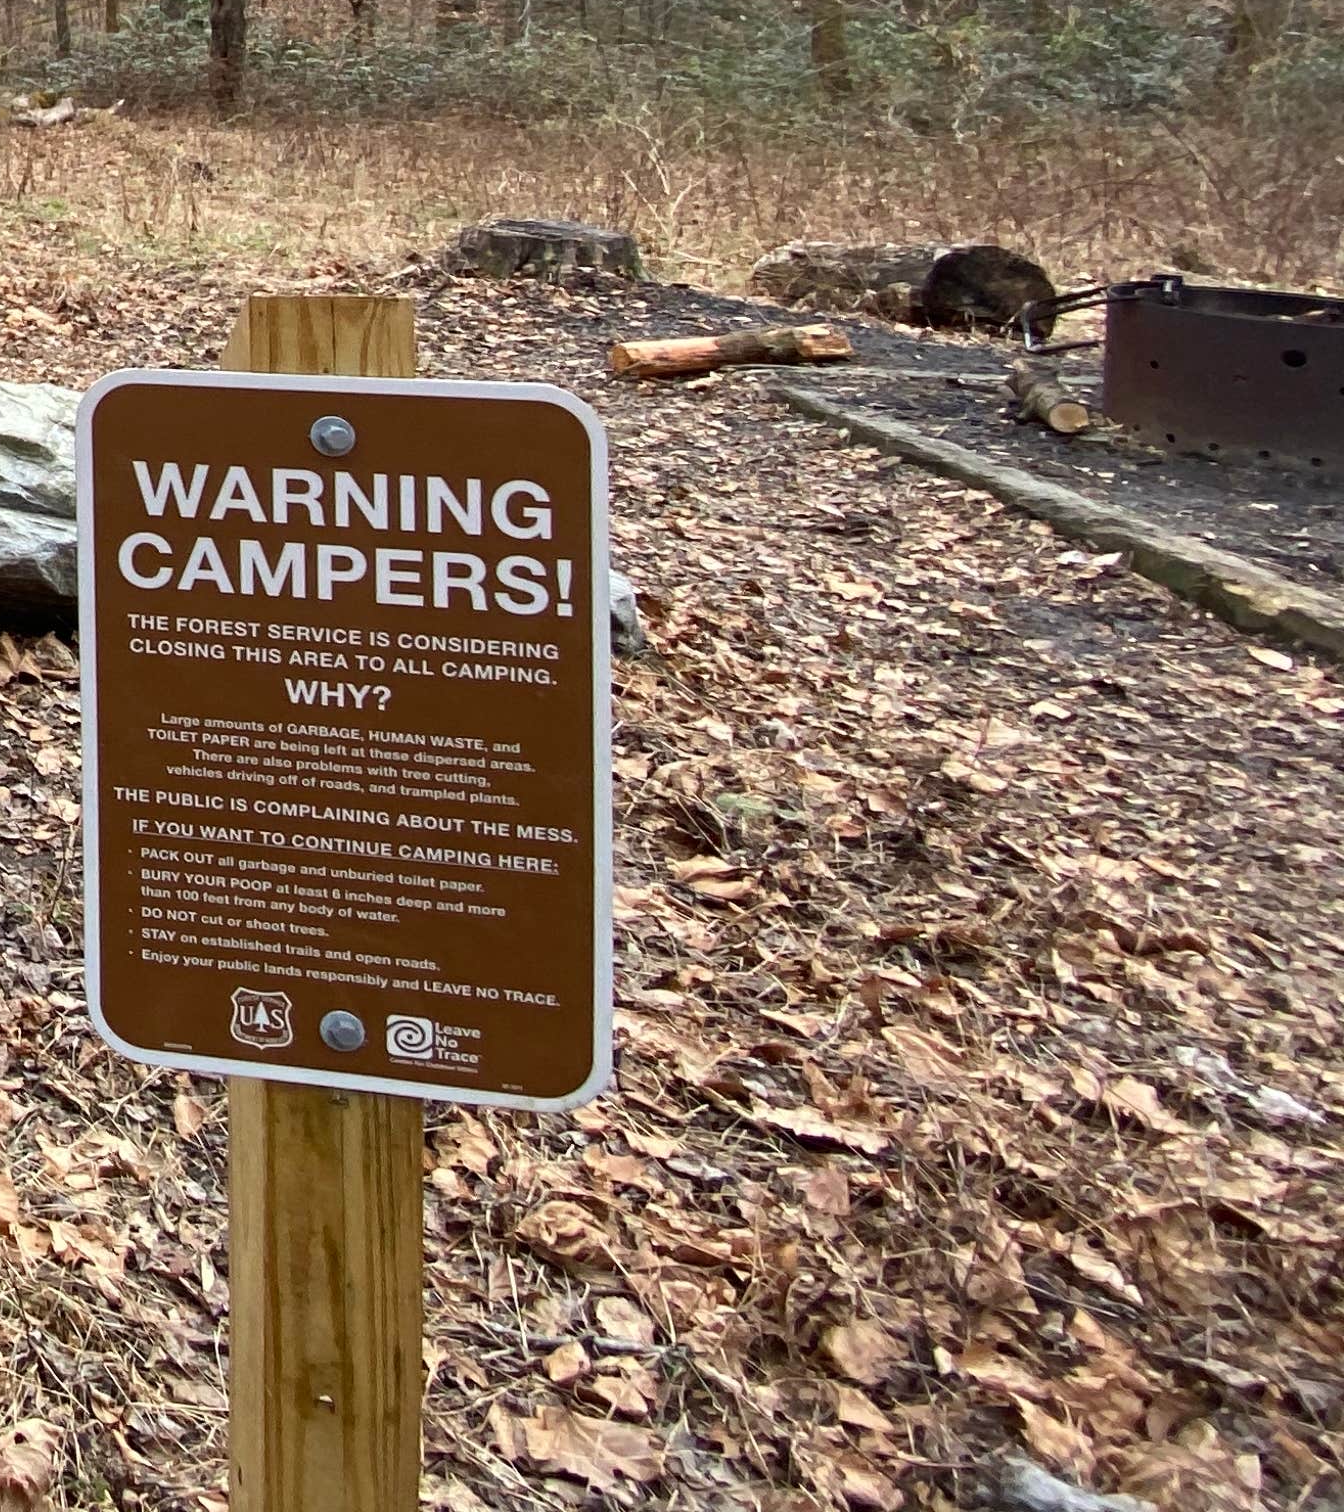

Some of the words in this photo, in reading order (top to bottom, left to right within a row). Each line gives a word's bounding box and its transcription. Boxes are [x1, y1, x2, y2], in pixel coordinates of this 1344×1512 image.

[132, 460, 552, 540] WARNING
[118, 532, 573, 617] CAMPERS!
[127, 613, 169, 631] THE
[176, 617, 260, 637] FOREST
[267, 623, 361, 645] SERVICE
[369, 631, 390, 647] IS
[397, 633, 559, 659] CONSIDERING
[129, 638, 225, 659] CLOSING
[231, 645, 281, 664] THIS
[288, 650, 348, 669] AREA
[354, 654, 385, 671] TO
[392, 658, 434, 675] ALL
[442, 661, 557, 685] CAMPING.
[284, 678, 391, 711] WHY?
[147, 728, 198, 742] TOILET
[202, 732, 250, 747] PAPER
[253, 739, 276, 750] are
[280, 740, 319, 755] being
[323, 743, 347, 756] left
[351, 747, 365, 758] at
[369, 748, 409, 761] these
[413, 751, 486, 768] dispersed
[490, 760, 535, 772] areas.
[161, 712, 200, 728] Large
[204, 718, 264, 732] amounts
[268, 722, 283, 733] of
[286, 723, 364, 741] GARBAGE,
[368, 730, 426, 745] HUMAN
[429, 735, 488, 752] WASTE,
[492, 743, 520, 753] and
[166, 765, 223, 779] vehicles
[227, 769, 274, 786] driving
[278, 774, 298, 785] off
[301, 776, 316, 787] of
[320, 779, 364, 793] roads,
[369, 783, 396, 794] and
[400, 785, 466, 801] trampled
[469, 791, 519, 806] plants.
[192, 748, 232, 763] There
[236, 755, 258, 765] are
[262, 755, 292, 768] also
[296, 759, 363, 775] problems
[366, 765, 397, 777] with
[401, 768, 430, 780] tree
[113, 786, 150, 802] THE
[155, 790, 223, 809] PUBLIC
[230, 797, 248, 812] IS
[253, 800, 390, 825] COMPLAINING
[396, 814, 465, 832] ABOUT
[470, 820, 510, 837] THE
[516, 824, 578, 843] MESS.
[133, 819, 149, 833] IF
[155, 821, 193, 836] YOU
[199, 824, 253, 842] WANT
[260, 830, 285, 845] TO
[291, 832, 392, 857] CONTINUE
[399, 844, 491, 866] CAMPING
[498, 854, 558, 873] HERE:
[141, 847, 180, 862] PACK
[183, 851, 214, 864] OUT
[218, 856, 234, 867] all
[238, 859, 296, 875] garbage
[300, 865, 326, 876] and
[330, 868, 394, 883] unburied
[398, 874, 435, 888] toilet
[439, 880, 484, 892] paper.
[141, 868, 180, 882] BURY
[184, 872, 226, 888] YOUR
[230, 877, 272, 892] POOP
[276, 884, 290, 894] at
[293, 884, 328, 898] least
[344, 890, 392, 905] inches
[396, 896, 432, 911] deep
[436, 901, 464, 912] and
[468, 905, 506, 917] more
[141, 885, 171, 899] than
[175, 889, 199, 901] 100
[202, 891, 230, 905] feet
[233, 895, 266, 908] from
[270, 901, 295, 913] any
[299, 901, 334, 917] body
[338, 907, 352, 917] of
[356, 910, 400, 922] water.
[141, 906, 163, 919] DO
[166, 909, 197, 922] NOT
[201, 915, 223, 925] cut
[227, 918, 242, 927] or
[246, 918, 285, 932] shoot
[289, 922, 329, 936] trees.
[141, 927, 176, 941] STAY
[180, 934, 197, 944] on
[201, 936, 281, 953] established
[285, 943, 321, 957] trails
[325, 950, 351, 961] and
[355, 953, 391, 965] open
[395, 958, 440, 971] roads.
[141, 948, 180, 965] Enjoy
[182, 955, 214, 967] your
[217, 959, 260, 972] public
[264, 962, 302, 977] lands
[306, 969, 388, 989] responsibly
[392, 979, 419, 990] and
[423, 980, 472, 996] LEAVE
[476, 986, 499, 999] NO
[503, 989, 560, 1006] TRACE.
[435, 1022, 481, 1039] Leave
[435, 1035, 458, 1048] No
[435, 1047, 479, 1064] Trace
